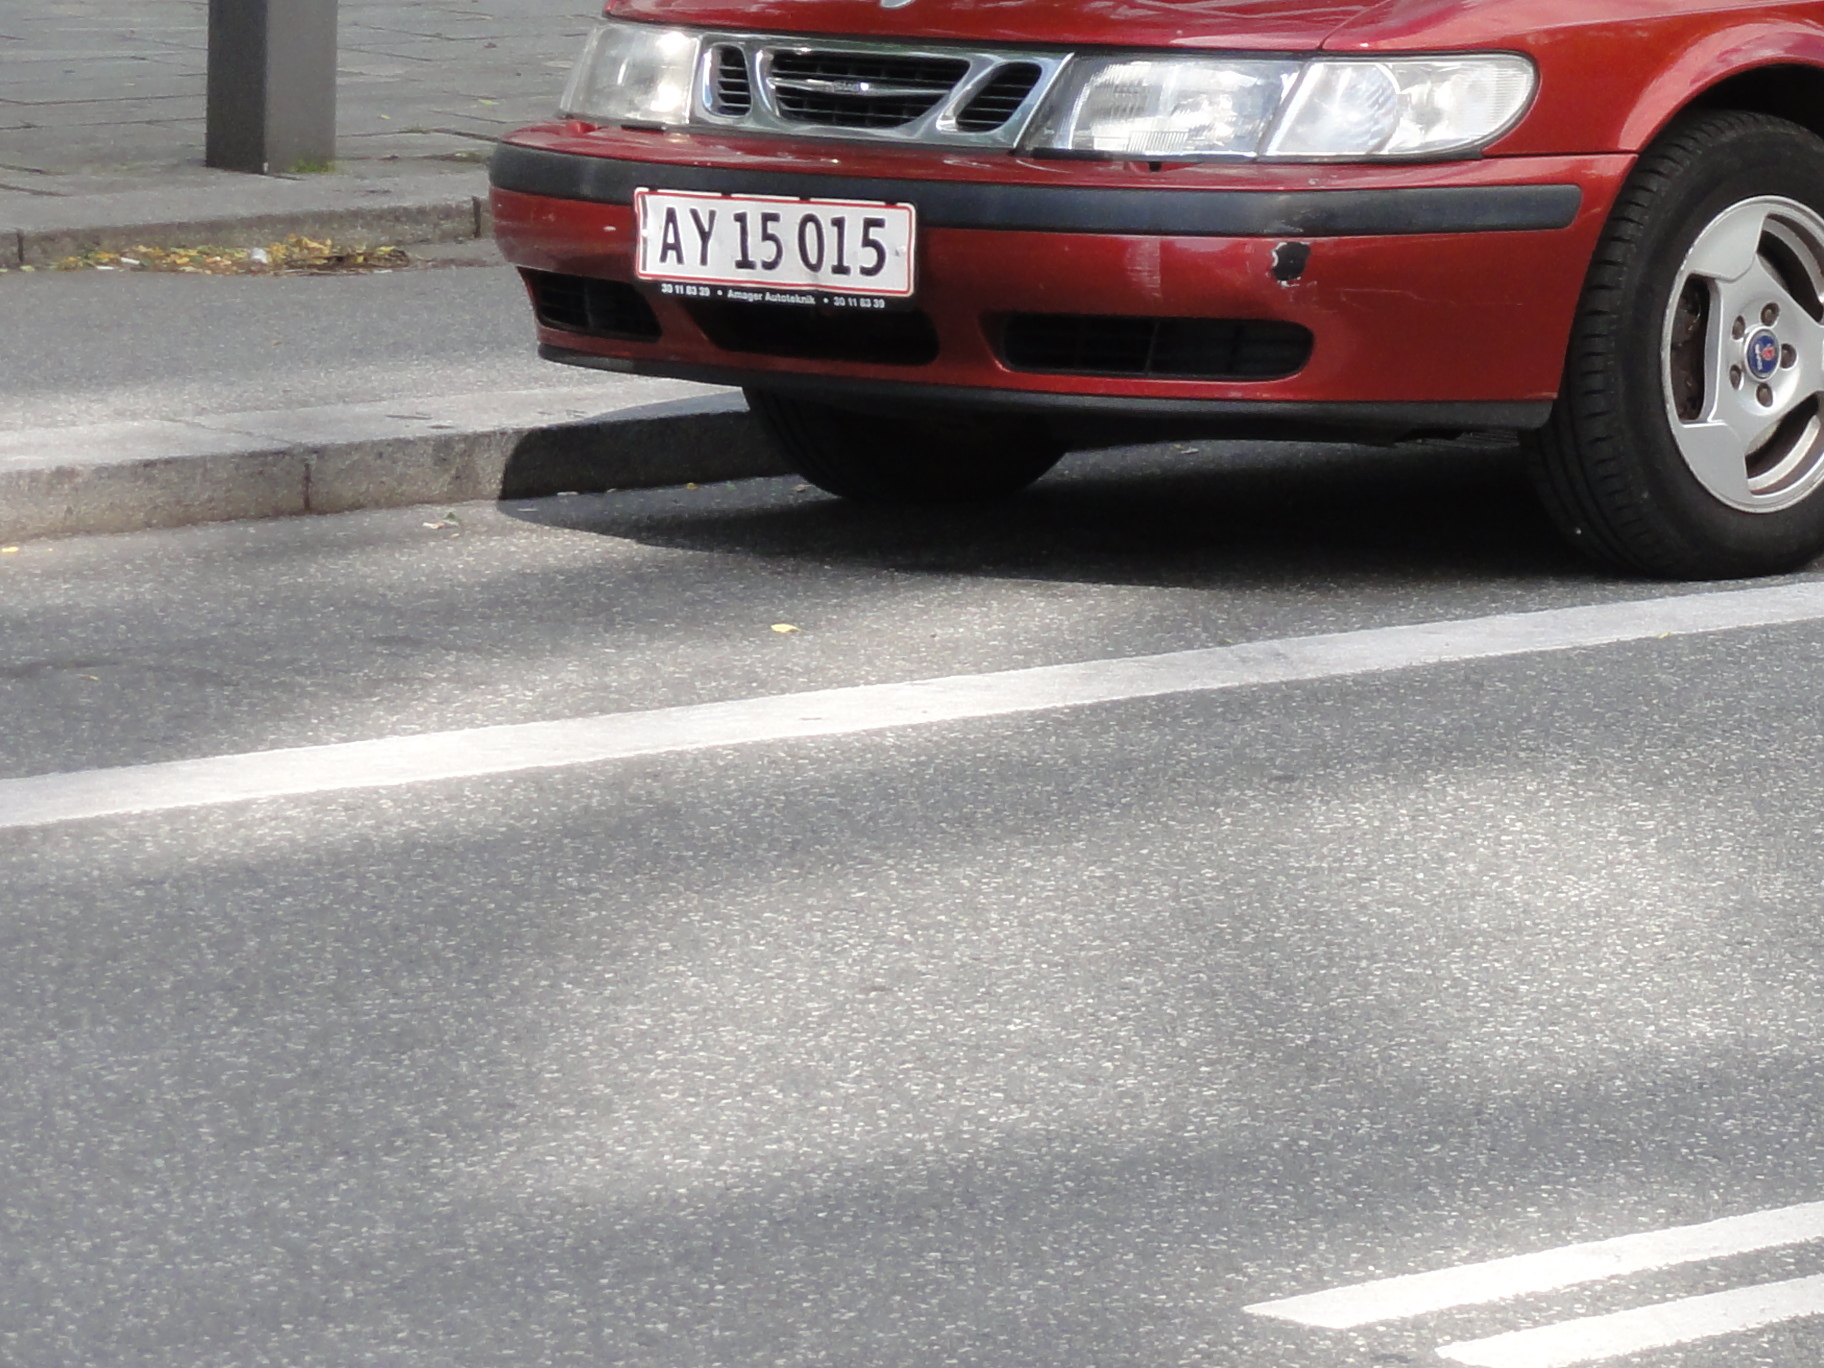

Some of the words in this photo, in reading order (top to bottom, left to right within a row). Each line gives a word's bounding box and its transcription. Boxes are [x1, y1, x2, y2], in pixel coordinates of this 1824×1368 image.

[659, 206, 717, 267] AY
[733, 211, 783, 271] 15
[797, 213, 887, 277] 015
[727, 289, 763, 302] Amager
[765, 291, 816, 305] Autoteknik
